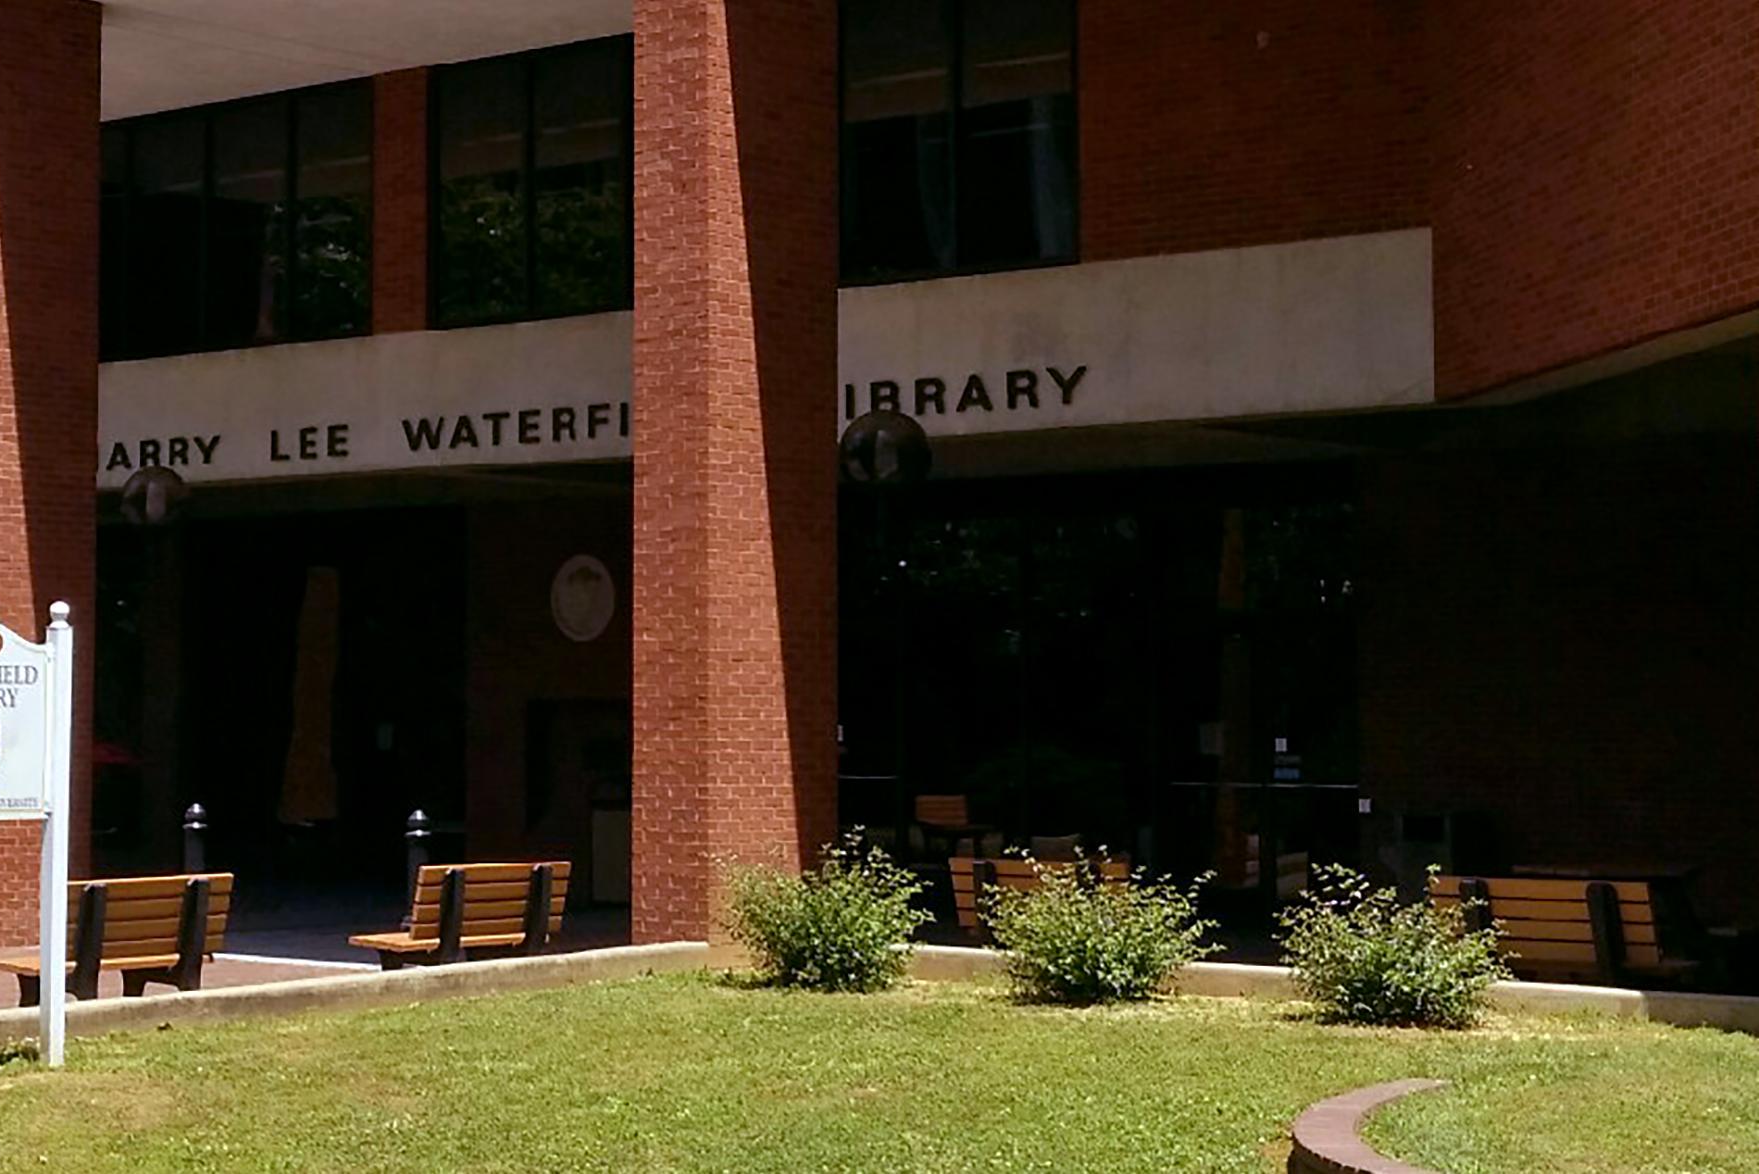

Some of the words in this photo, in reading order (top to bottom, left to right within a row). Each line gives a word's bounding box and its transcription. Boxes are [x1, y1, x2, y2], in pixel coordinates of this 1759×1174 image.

[106, 435, 221, 470] ARRY
[270, 424, 349, 461] LEE
[401, 402, 629, 450] WATERFI
[845, 365, 1087, 420] IBRARY
